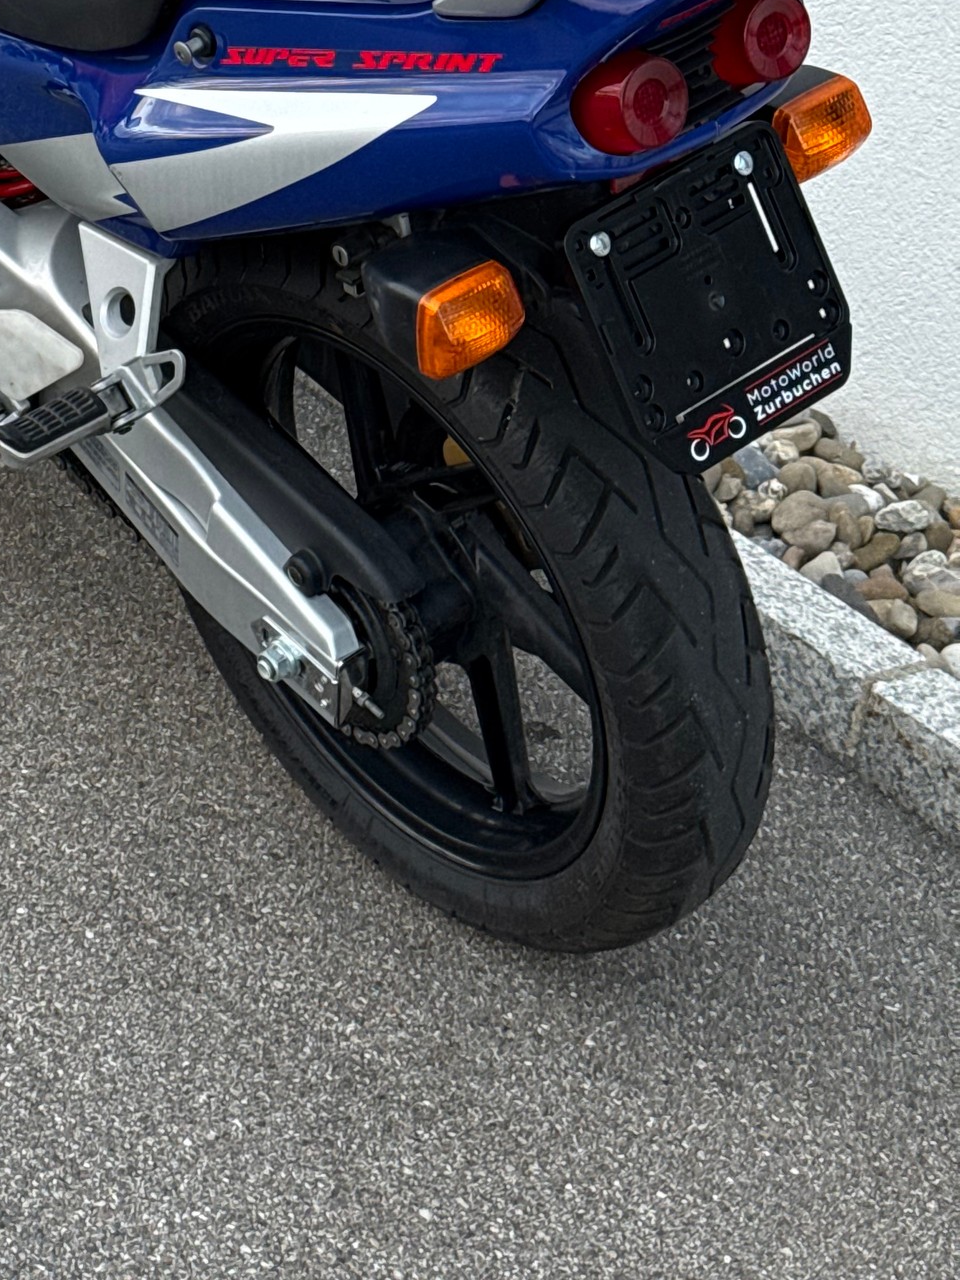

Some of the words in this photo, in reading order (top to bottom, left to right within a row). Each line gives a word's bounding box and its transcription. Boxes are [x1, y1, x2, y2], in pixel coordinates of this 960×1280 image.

[220, 46, 336, 68] SUPER
[352, 50, 503, 73] SPRINT
[746, 342, 836, 407] MotoWorld
[753, 361, 842, 422] Zurbuchen
